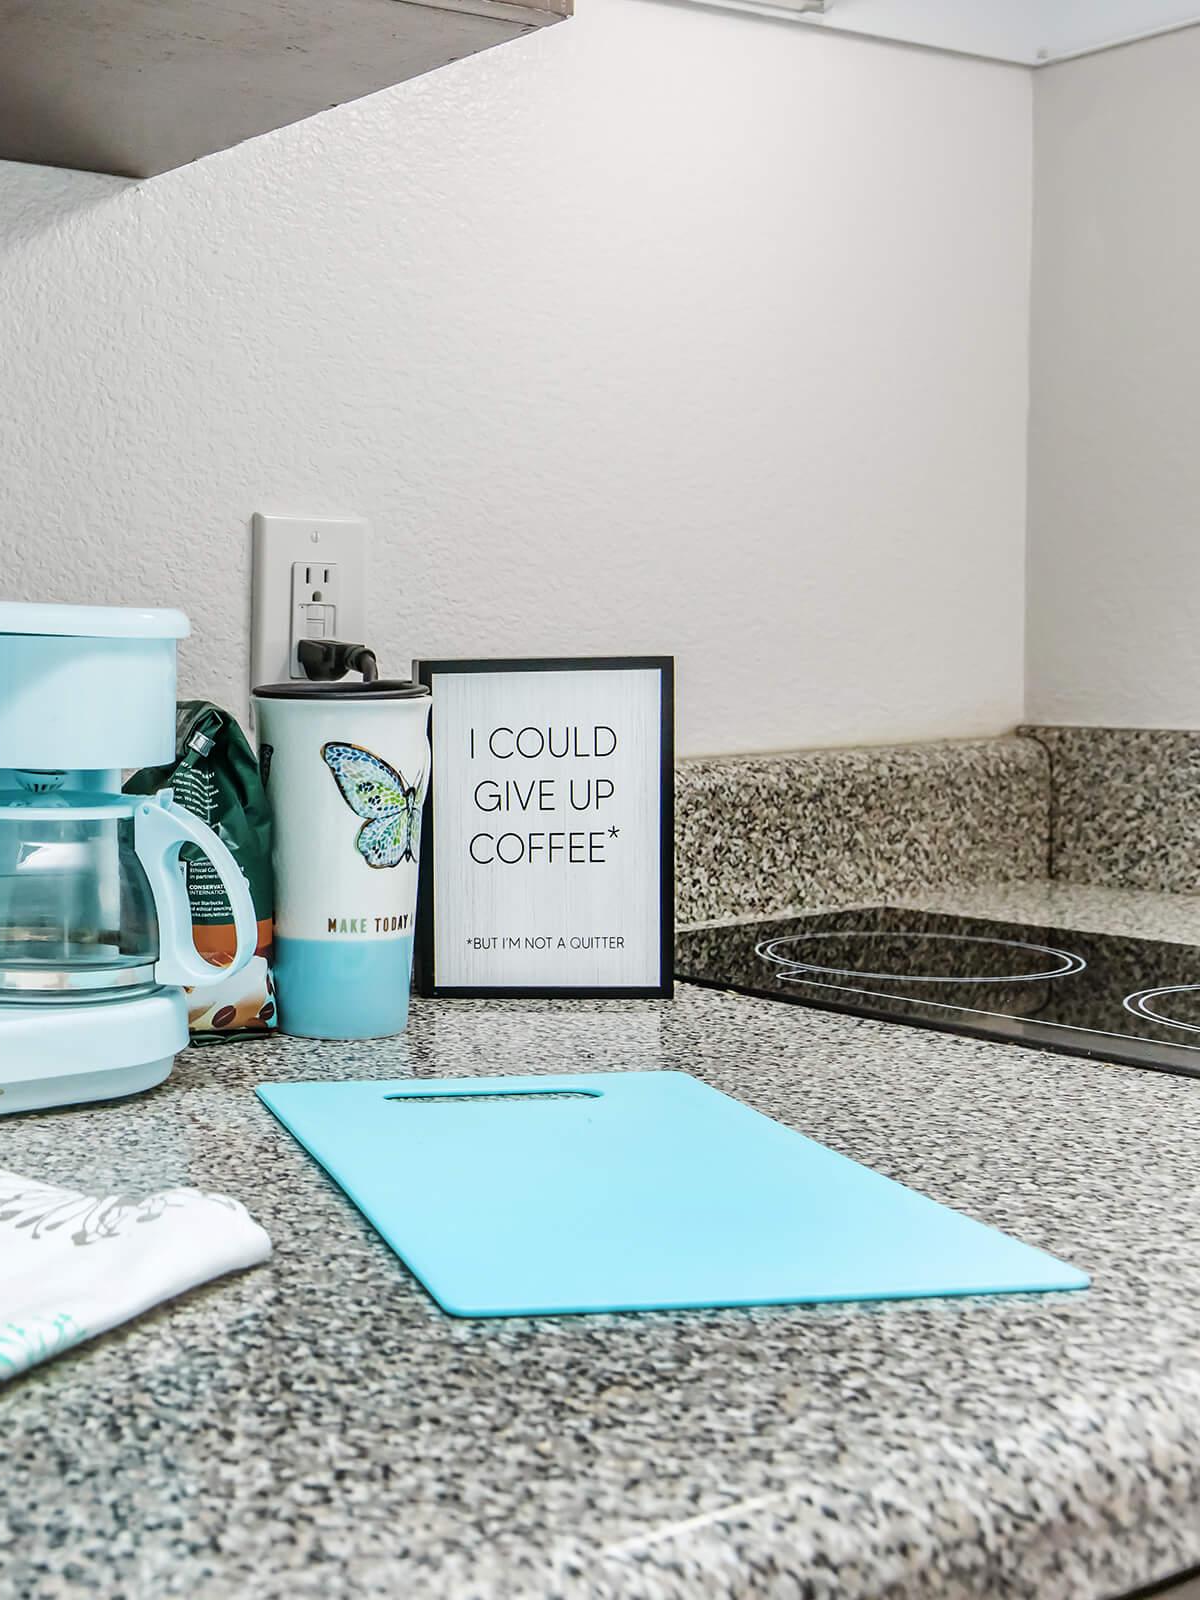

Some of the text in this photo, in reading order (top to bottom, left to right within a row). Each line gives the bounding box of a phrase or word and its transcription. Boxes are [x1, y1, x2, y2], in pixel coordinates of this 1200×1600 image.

[470, 726, 617, 759] I COULD
[474, 779, 615, 812] GIVE UP
[327, 917, 368, 934] MAKE
[373, 912, 409, 933] TODAY
[502, 936, 521, 950] I'M
[524, 936, 553, 950] NOT
[556, 936, 567, 950] A
[569, 936, 625, 950] QUITTER
